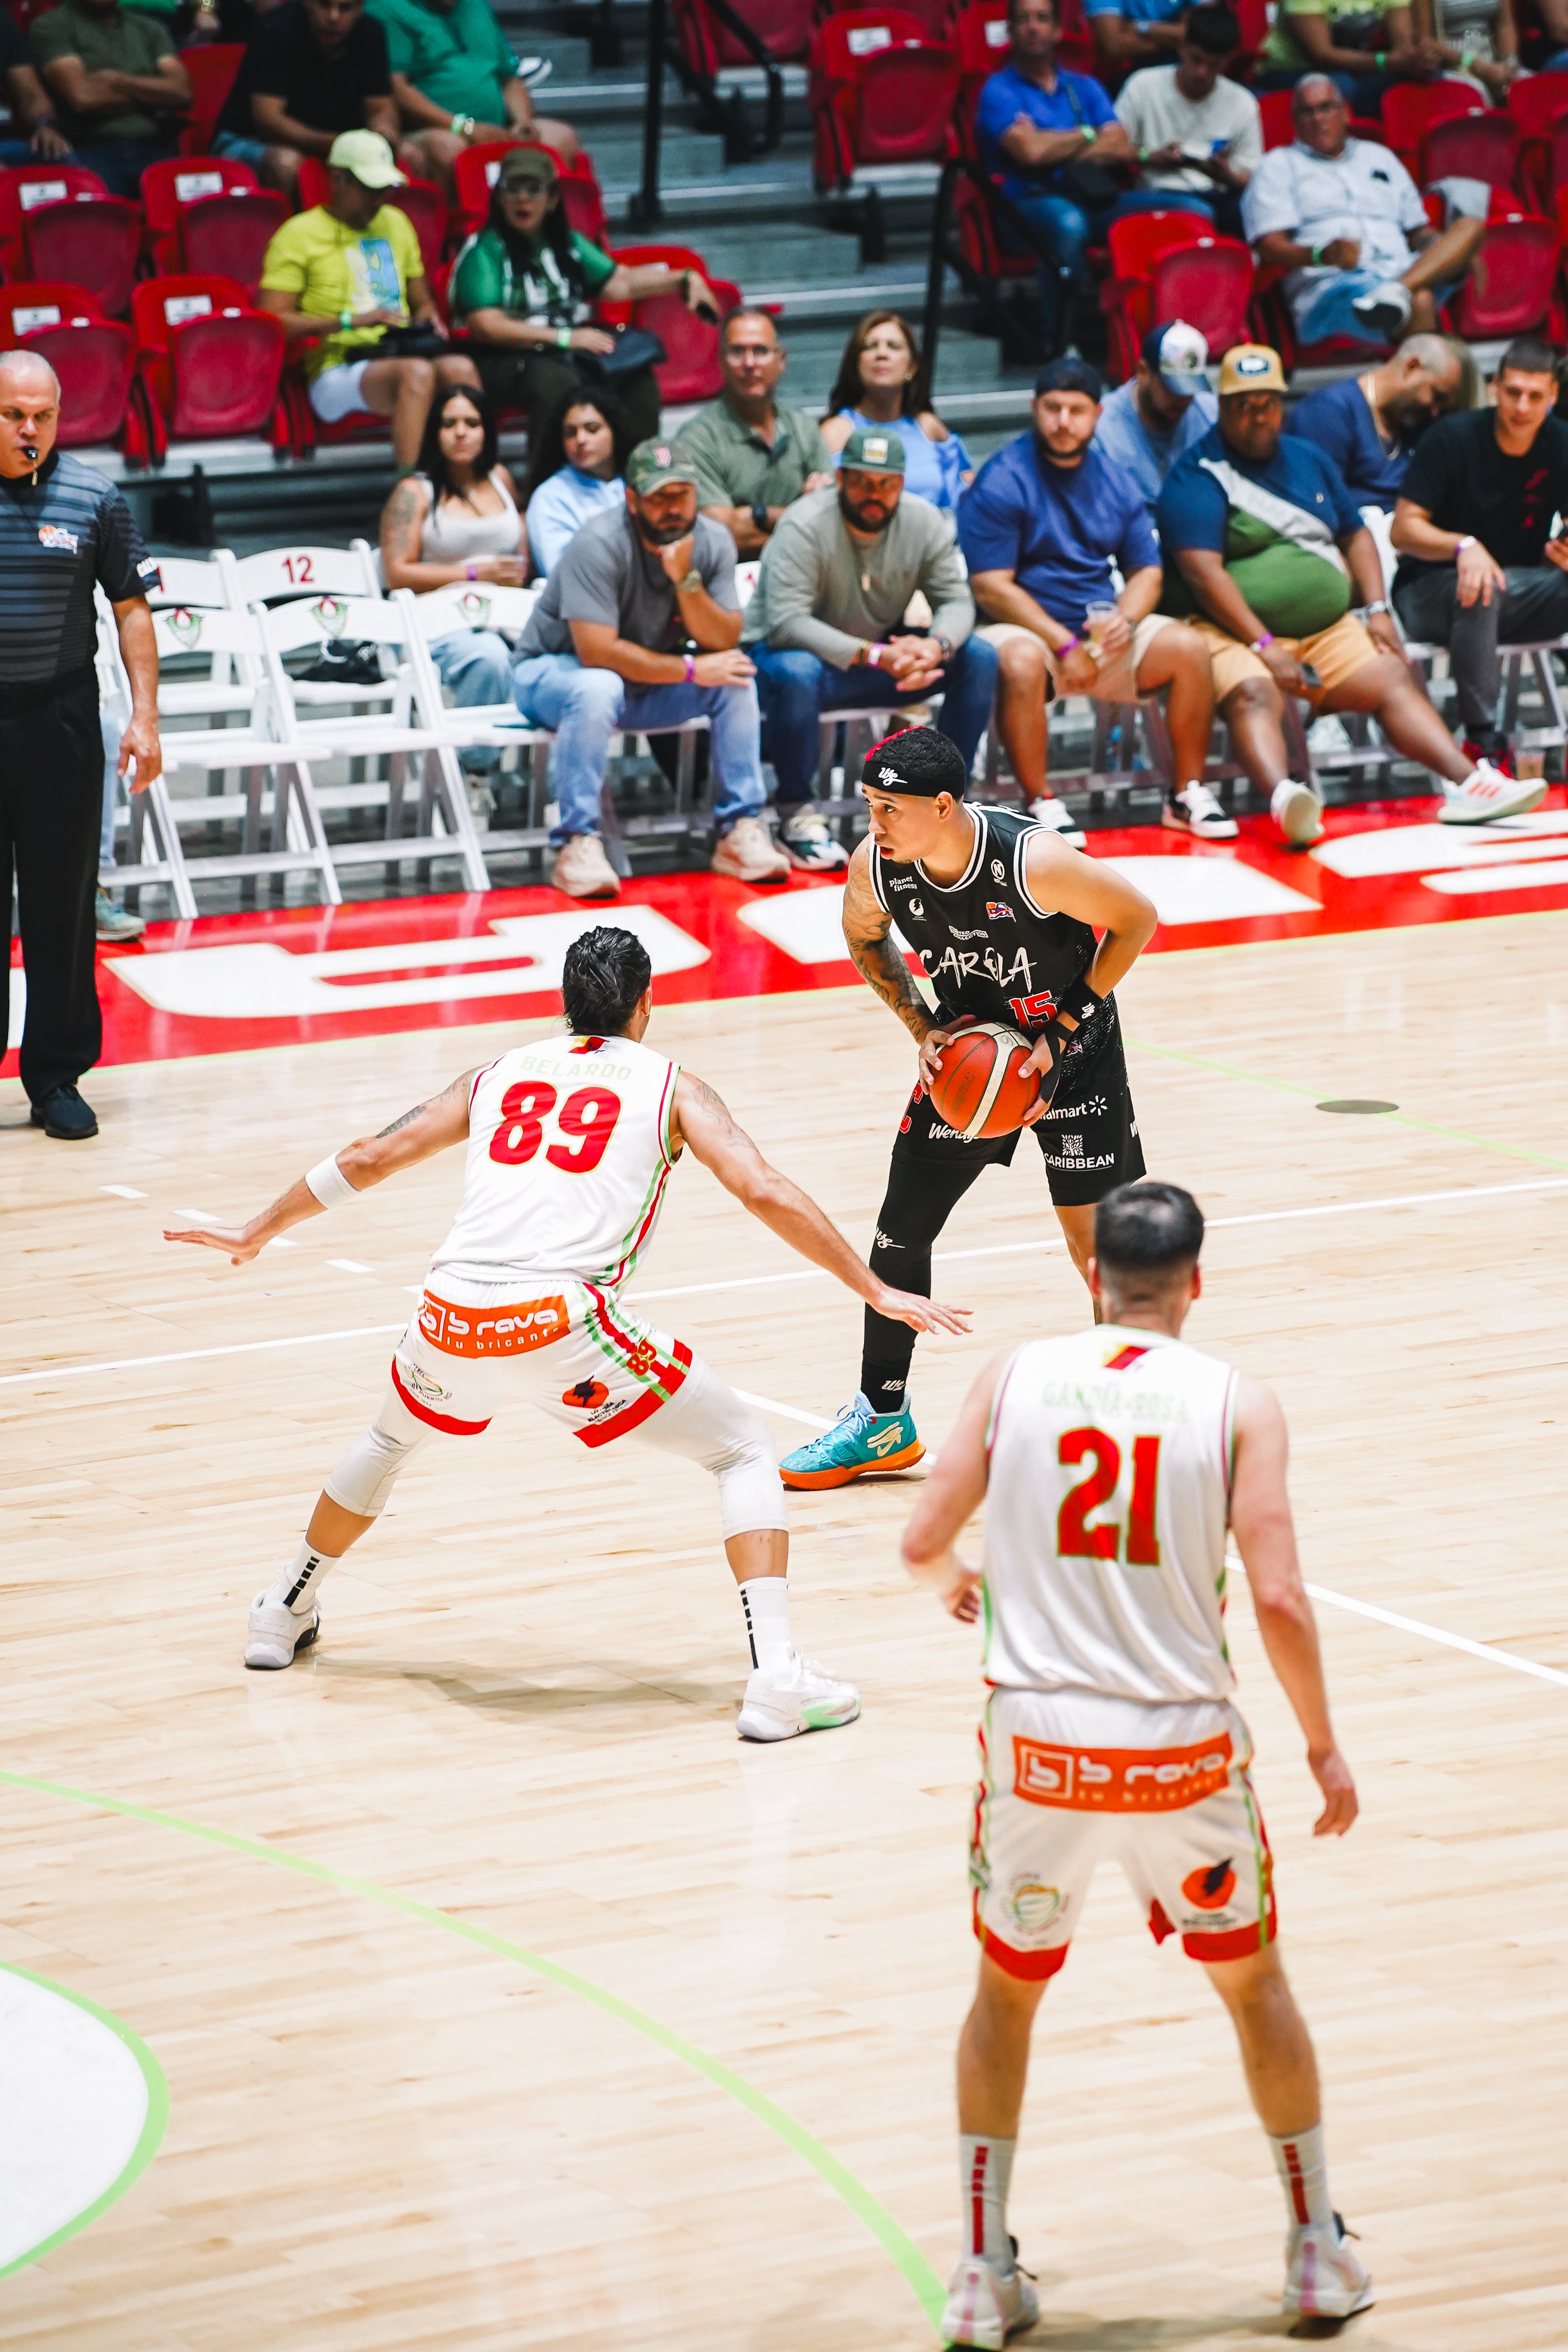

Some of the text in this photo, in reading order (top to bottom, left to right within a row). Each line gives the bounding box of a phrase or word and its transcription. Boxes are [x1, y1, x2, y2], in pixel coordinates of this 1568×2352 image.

[282, 556, 313, 583] 12
[889, 876, 913, 887] planet
[894, 882, 918, 892] fitness
[919, 946, 1037, 993] CAROLA
[1009, 990, 1058, 1029] 15
[520, 1056, 632, 1081] BELARDO
[489, 1080, 622, 1176] 89
[1044, 1153, 1115, 1169] CARIBBEAN
[1057, 1426, 1161, 1566] 21
